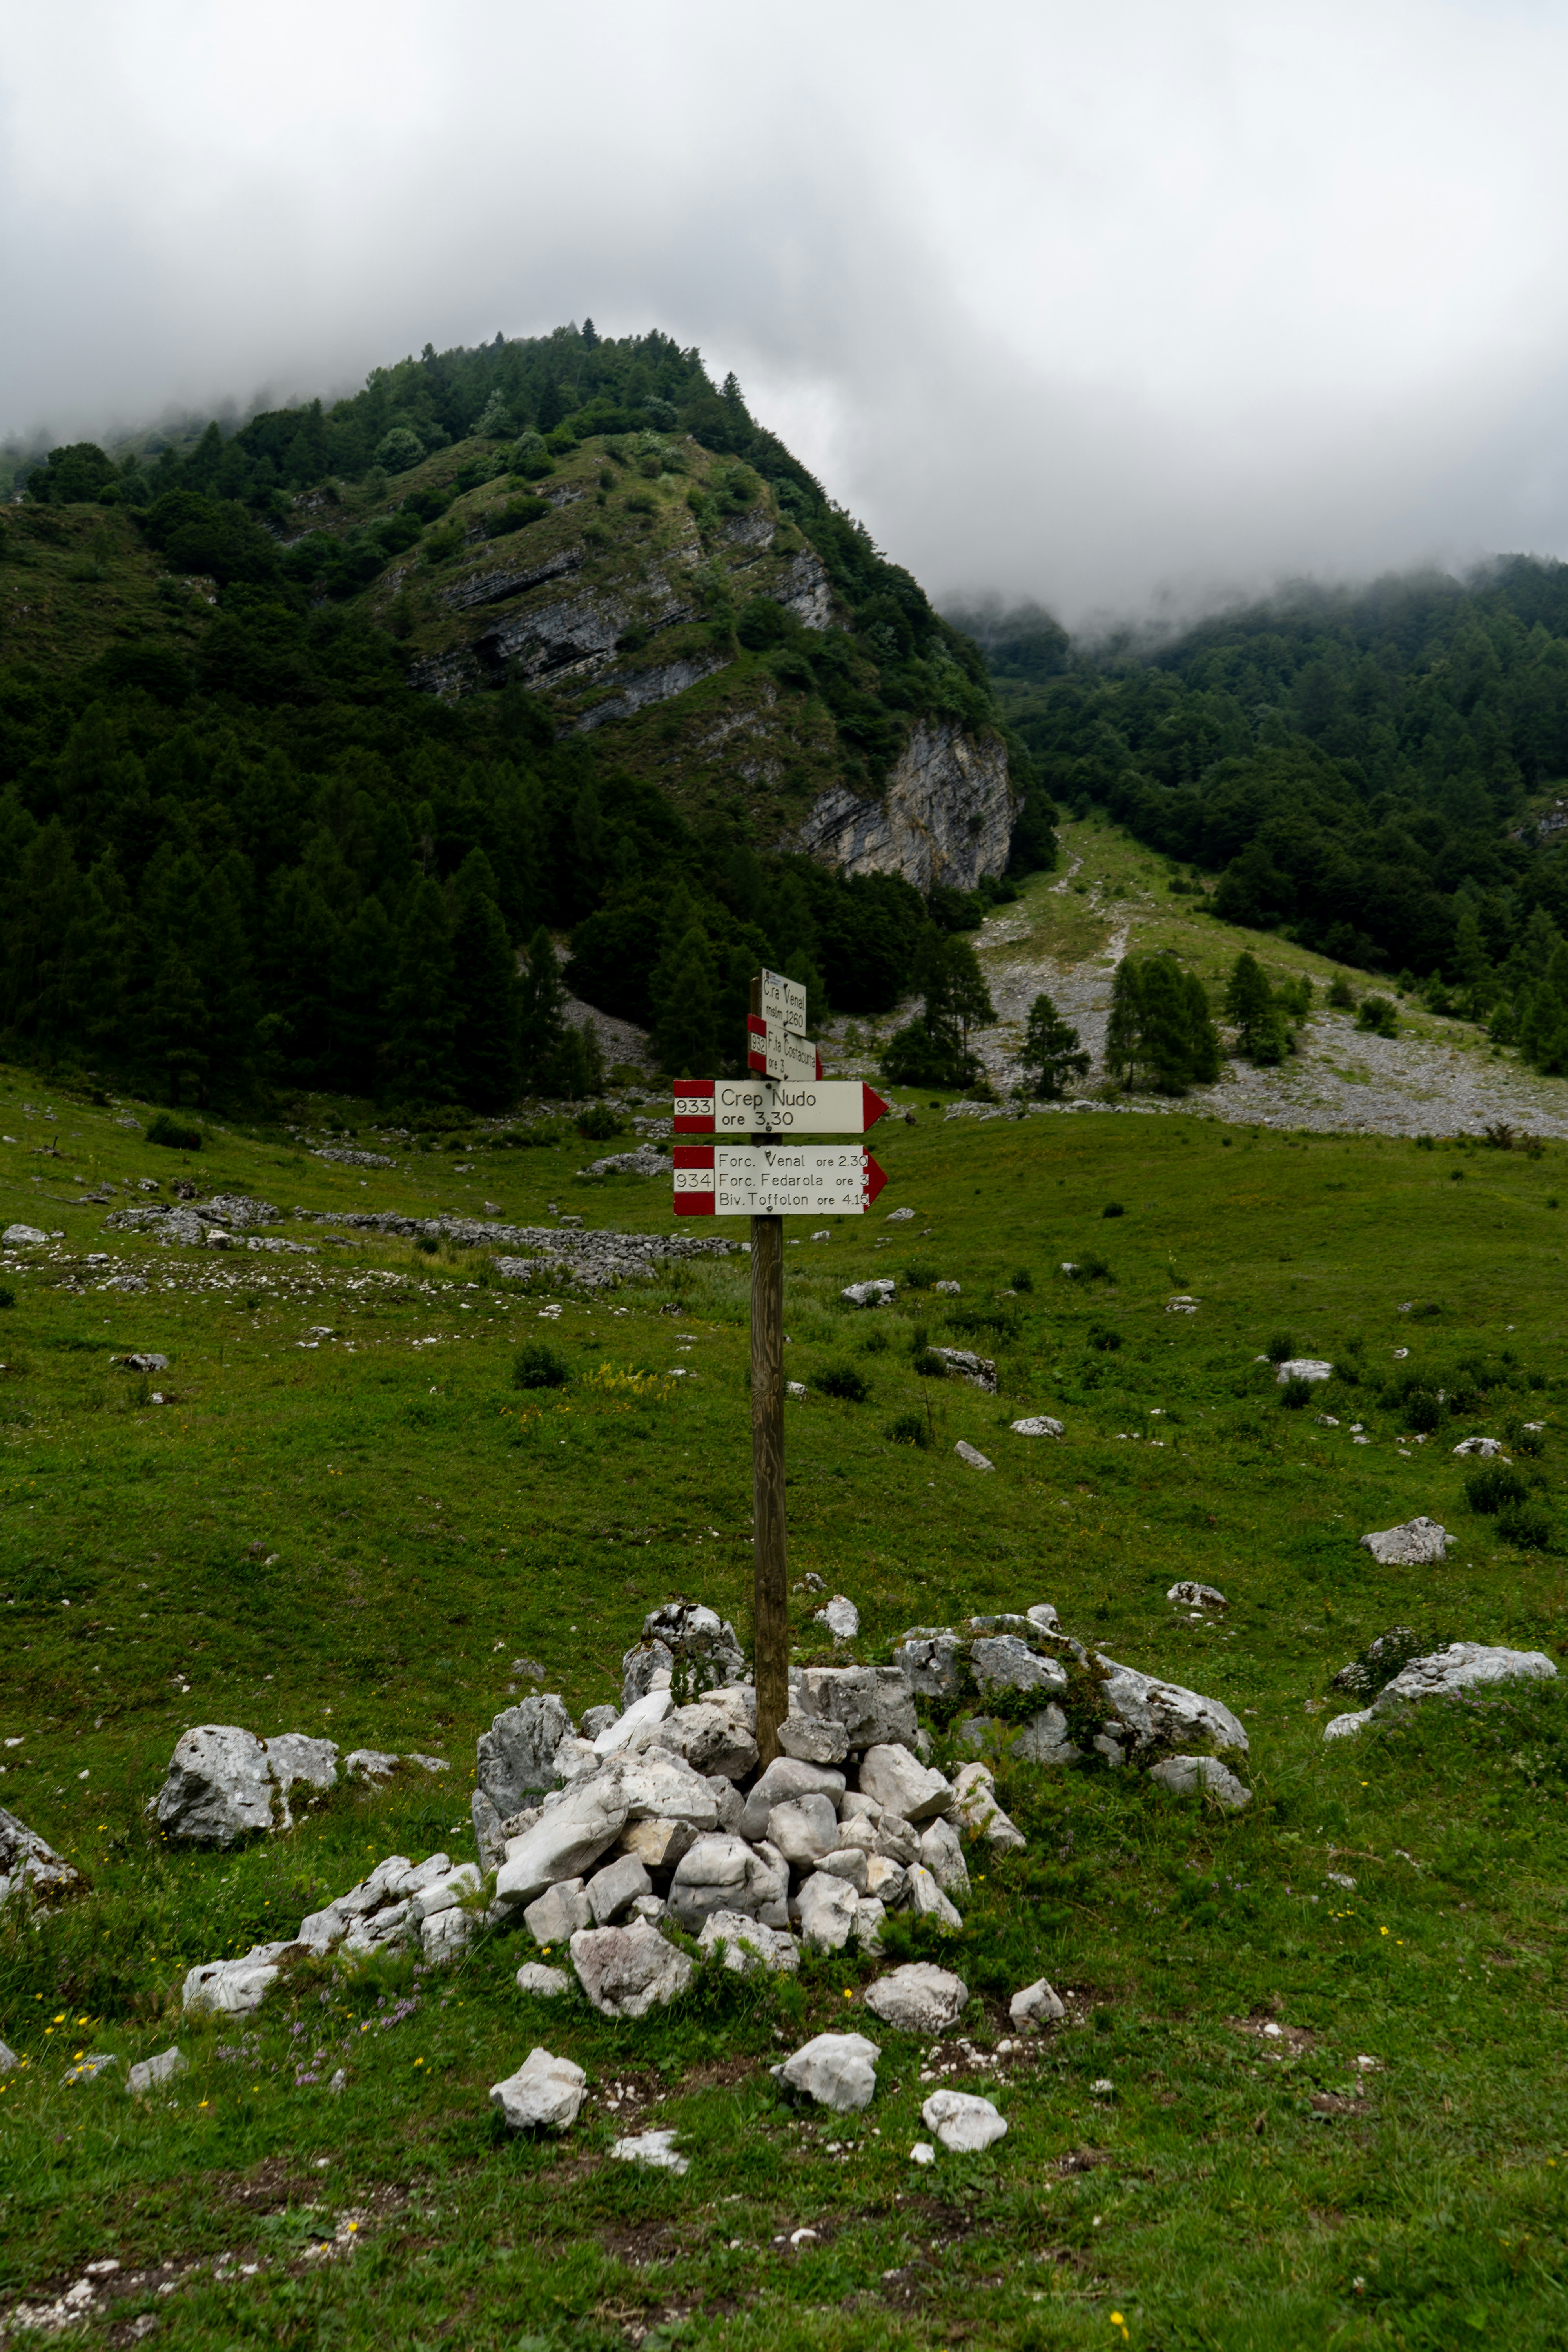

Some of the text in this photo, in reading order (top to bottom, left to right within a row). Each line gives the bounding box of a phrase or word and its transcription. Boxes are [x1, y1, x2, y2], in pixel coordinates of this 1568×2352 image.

[784, 987, 805, 1010] Venal
[766, 1005, 803, 1028] mslm 1260
[752, 1035, 765, 1053] 932
[784, 1038, 816, 1067] Costacurta
[769, 1058, 784, 1073] ore 3
[677, 1100, 710, 1113] 933
[722, 1089, 816, 1110] Crep Nudo
[722, 1116, 745, 1125] ore
[719, 1154, 868, 1167] Forc. Venal ore 2.30
[677, 1174, 711, 1187] 934
[719, 1173, 756, 1187] Forc.
[761, 1173, 823, 1186] Fedarola
[860, 1175, 869, 1186] 3
[720, 1192, 745, 1206] Biv.
[747, 1192, 808, 1205] Toffolon
[842, 1194, 869, 1205] 4.15
